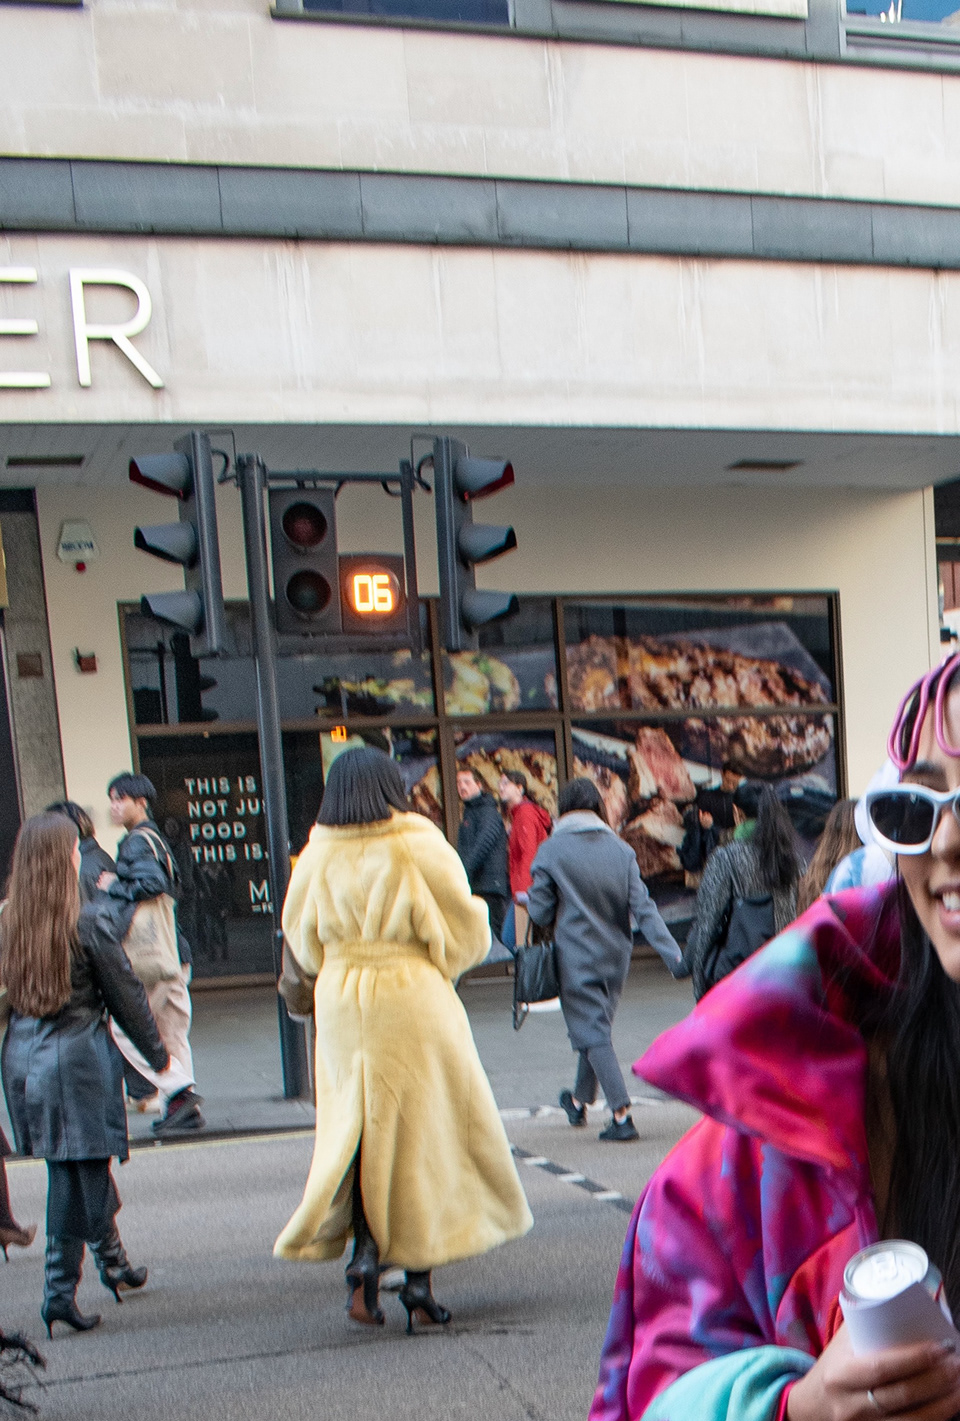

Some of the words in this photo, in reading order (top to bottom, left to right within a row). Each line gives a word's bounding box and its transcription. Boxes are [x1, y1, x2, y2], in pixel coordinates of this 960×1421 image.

[353, 574, 393, 612] 06
[184, 776, 231, 796] THIS
[237, 775, 257, 794] IS
[187, 799, 228, 819] NOT
[235, 798, 266, 816] JU
[189, 821, 247, 842] FOOD
[191, 844, 238, 864] THIS
